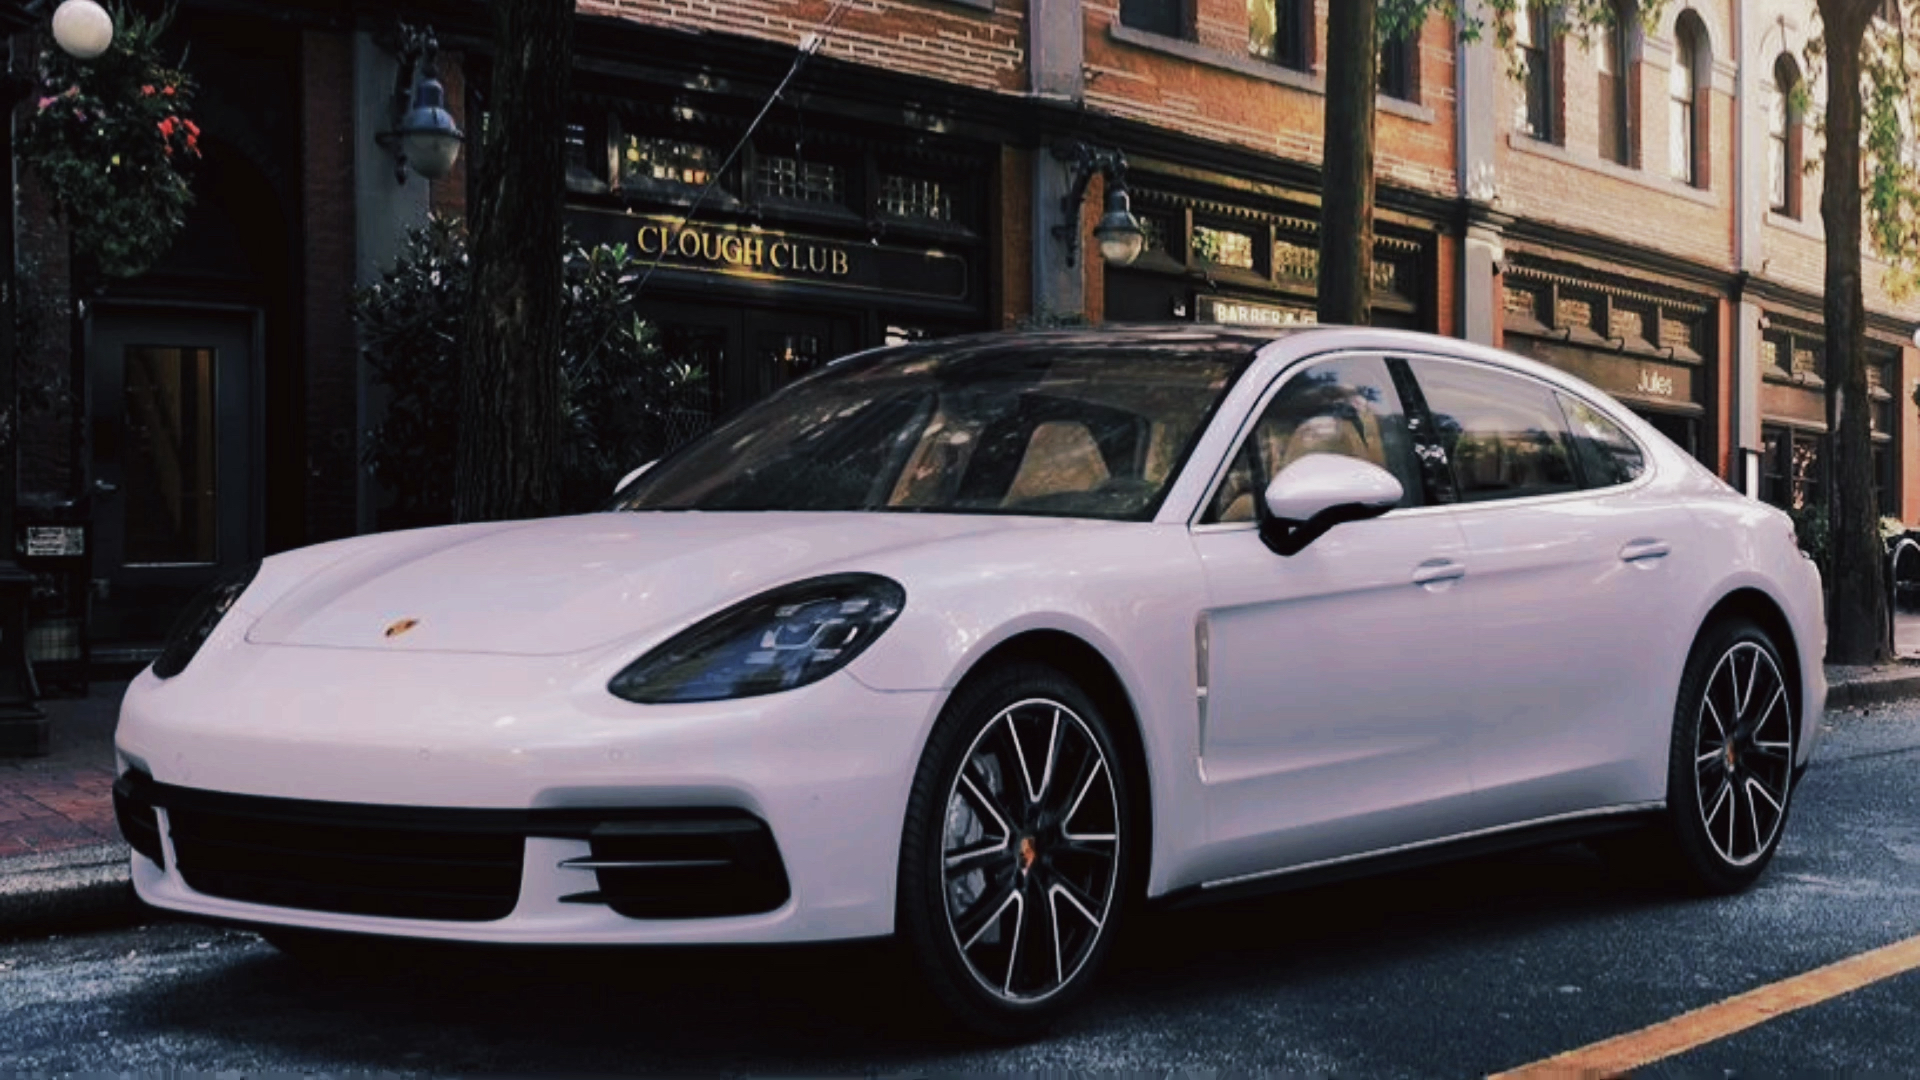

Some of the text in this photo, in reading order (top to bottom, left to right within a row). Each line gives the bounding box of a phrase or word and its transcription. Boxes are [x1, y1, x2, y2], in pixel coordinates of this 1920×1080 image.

[637, 225, 849, 275] CLOUGH CLUB
[1216, 302, 1280, 323] BARBER
[1637, 368, 1673, 396] Jules
